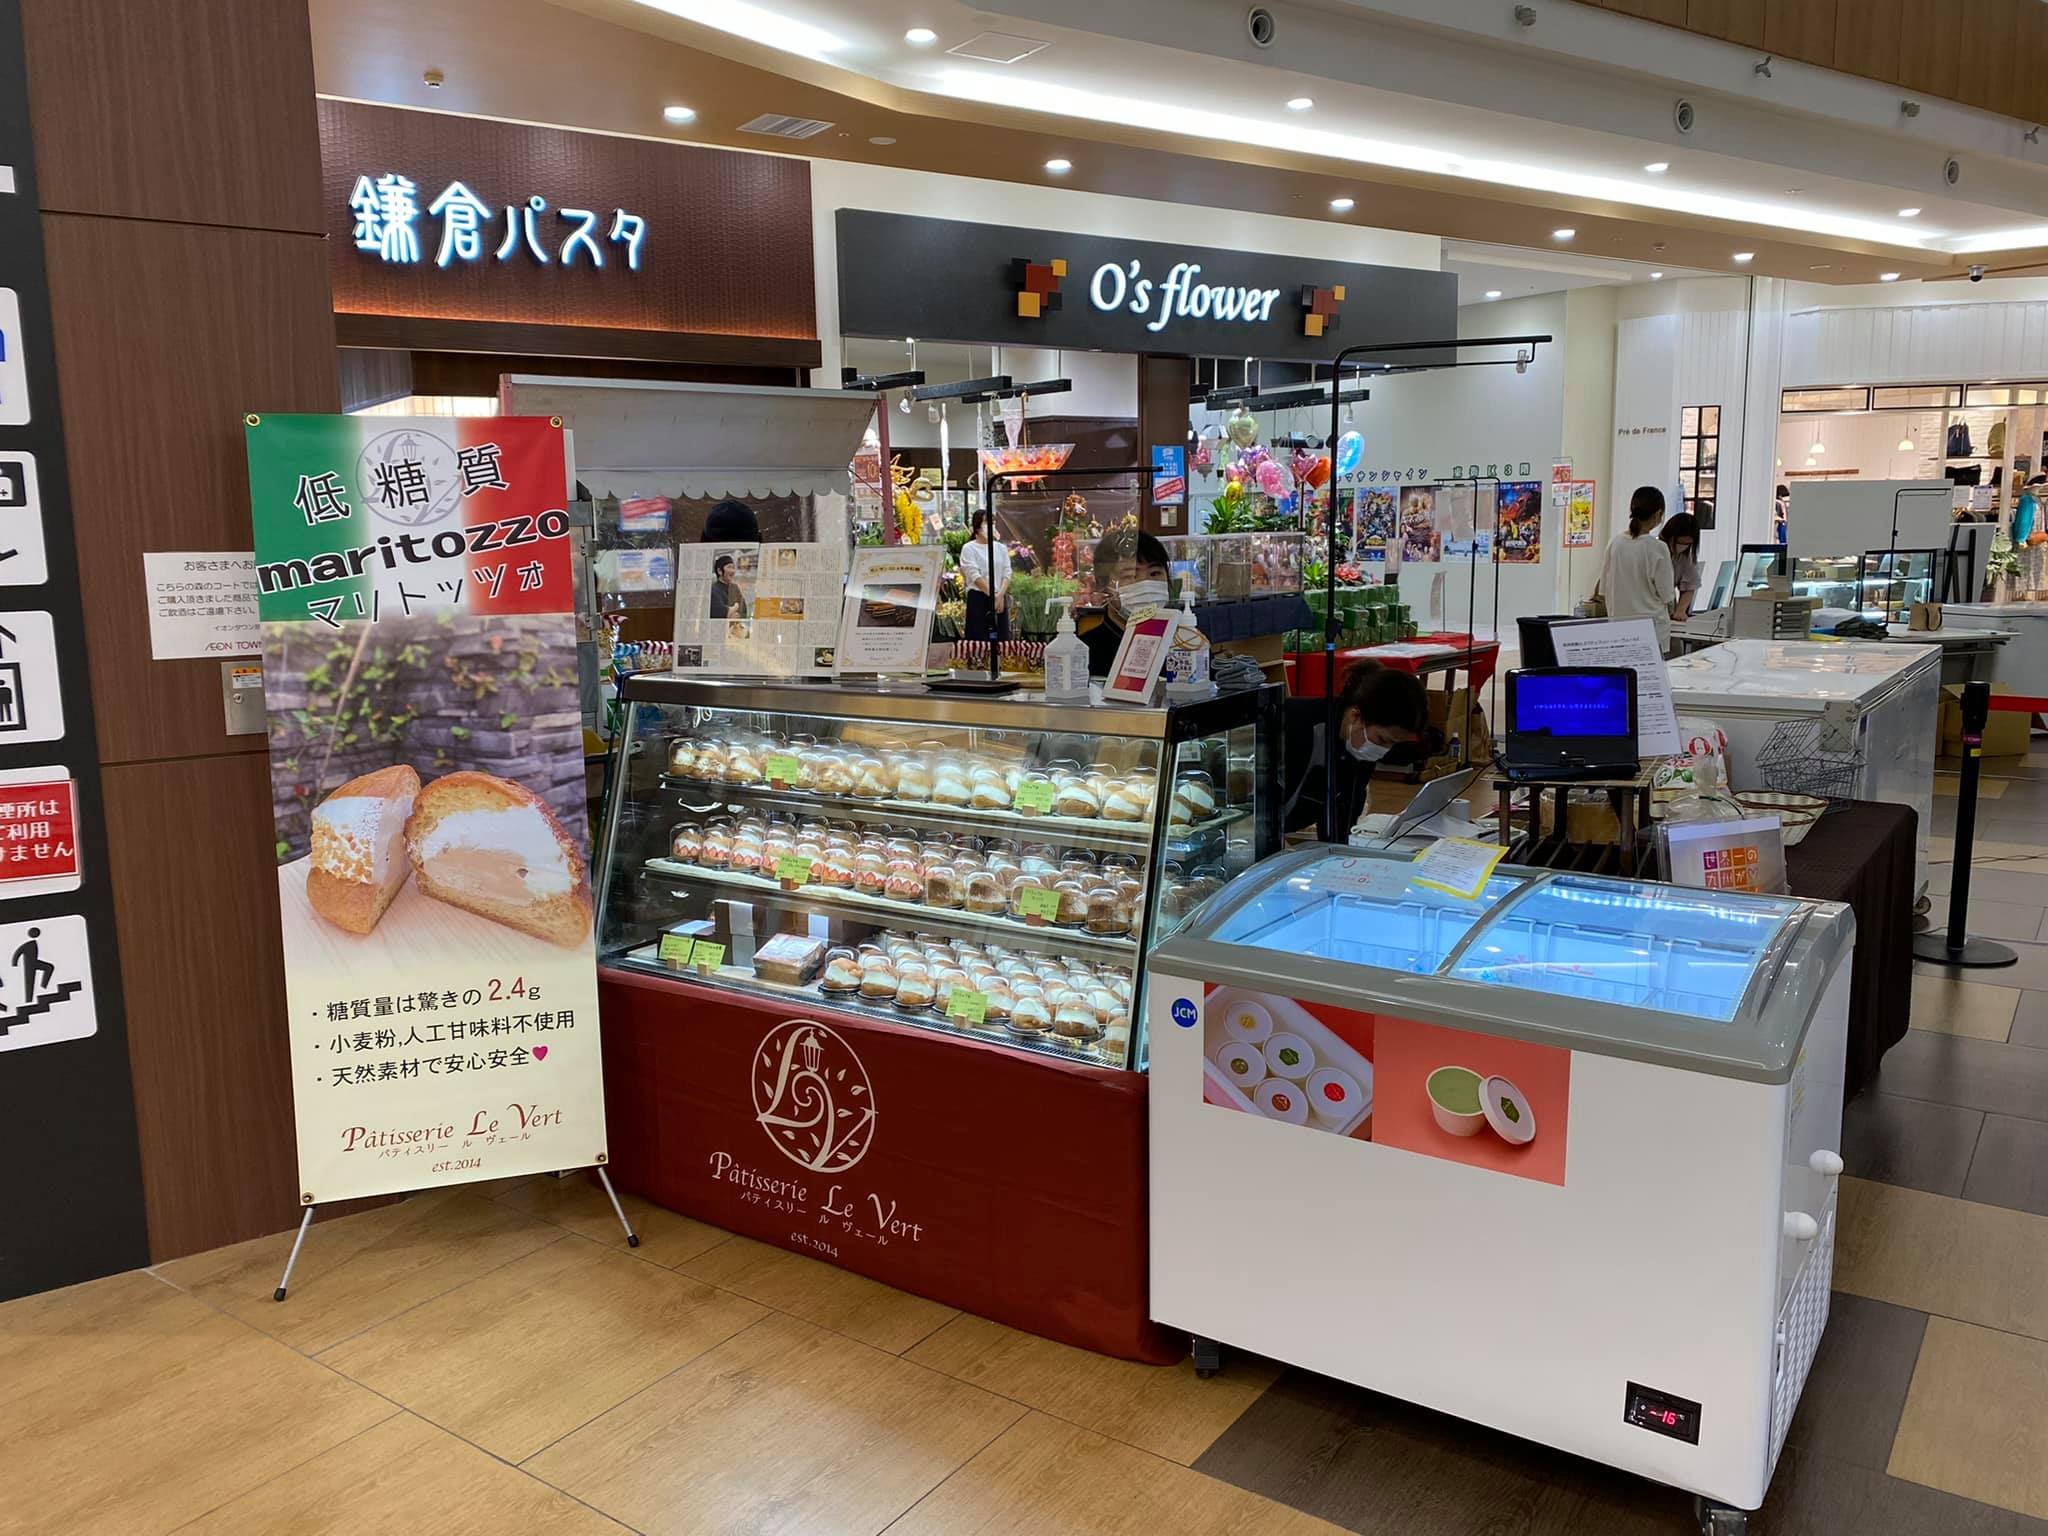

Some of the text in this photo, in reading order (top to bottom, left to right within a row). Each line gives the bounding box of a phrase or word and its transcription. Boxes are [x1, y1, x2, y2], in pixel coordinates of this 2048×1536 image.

[349, 173, 645, 270] 鎌倉パスタ
[1090, 259, 1281, 333] O's flower
[1643, 426, 1666, 434] France
[184, 560, 256, 572] お客さまへお
[256, 509, 569, 594] maritozzo
[307, 560, 545, 629] マリトッツォ
[1173, 1007, 1196, 1020] JCM
[341, 1103, 563, 1152] Pâtisserie Le Vert
[431, 1157, 482, 1174] est.2014
[709, 1151, 923, 1242] Pâtisserie Le Vert
[790, 1231, 840, 1259] est.2014
